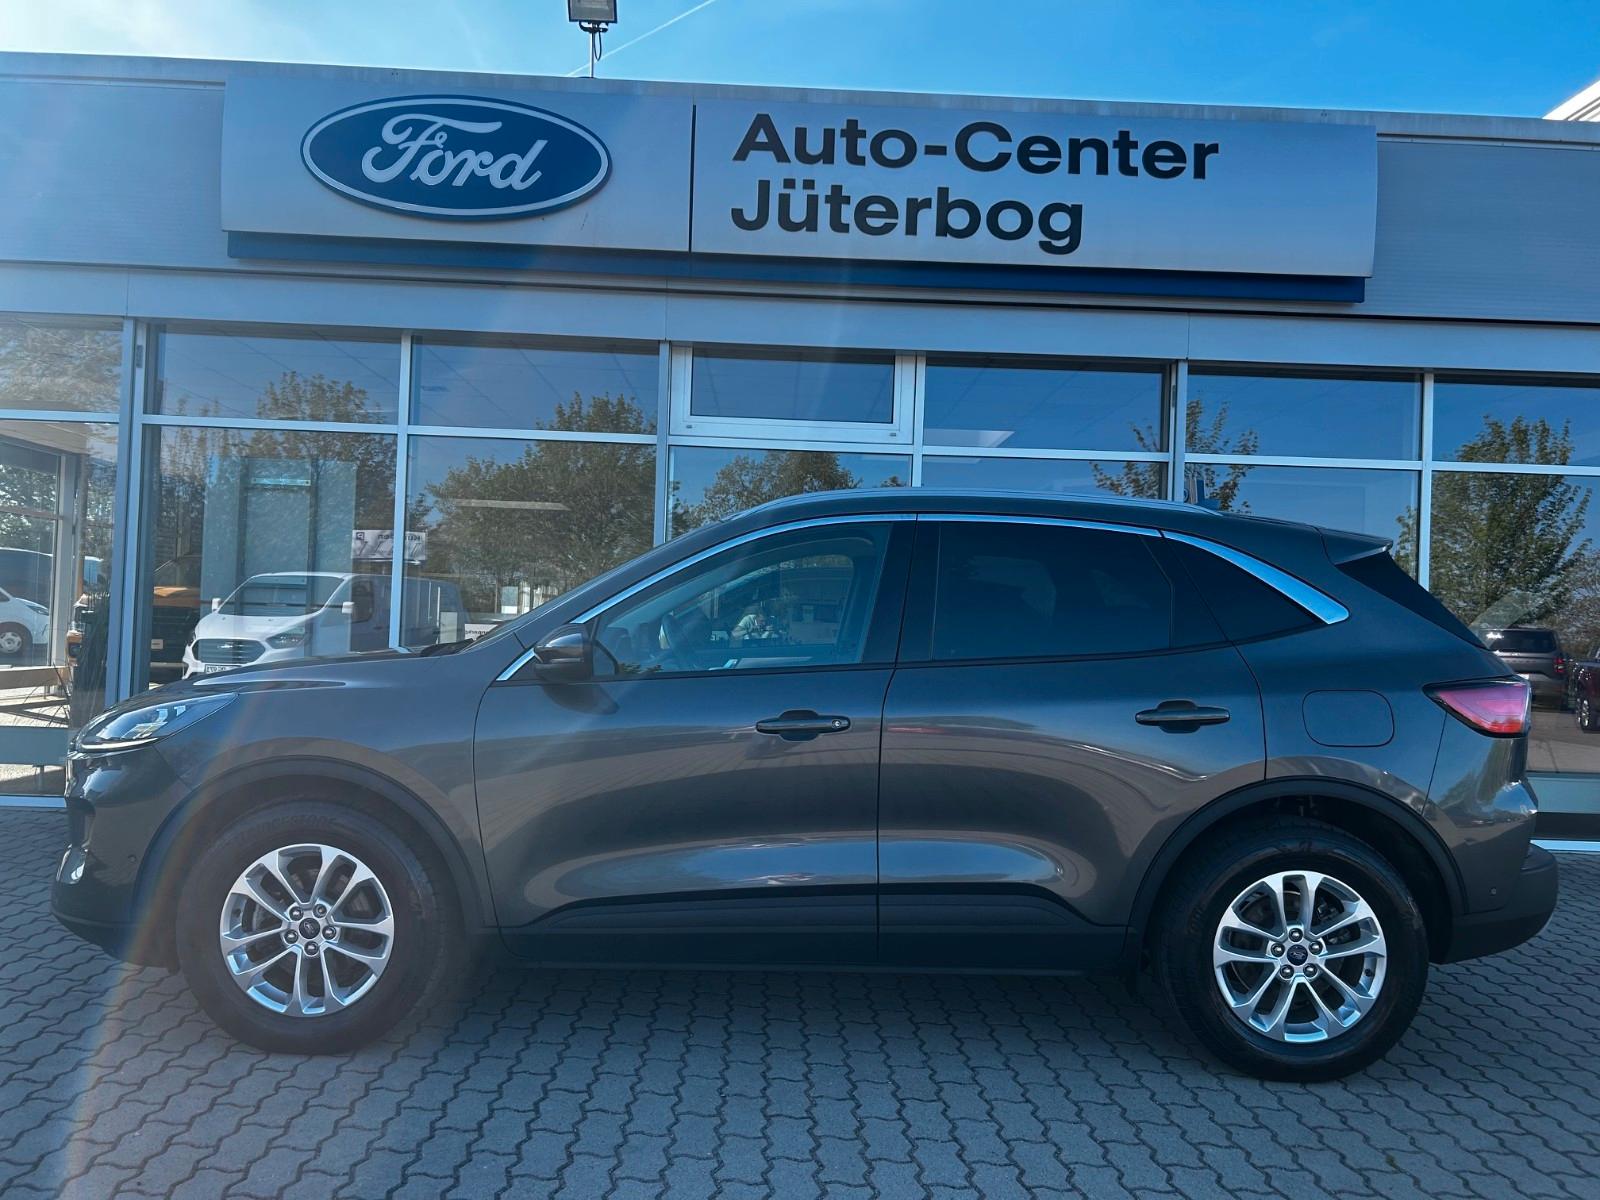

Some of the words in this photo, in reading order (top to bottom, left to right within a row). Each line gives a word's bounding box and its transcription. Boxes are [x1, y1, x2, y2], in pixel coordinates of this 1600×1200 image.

[361, 112, 549, 192] Ford
[732, 113, 1219, 180] Auto-Center
[731, 179, 1083, 255] Jüterbog
